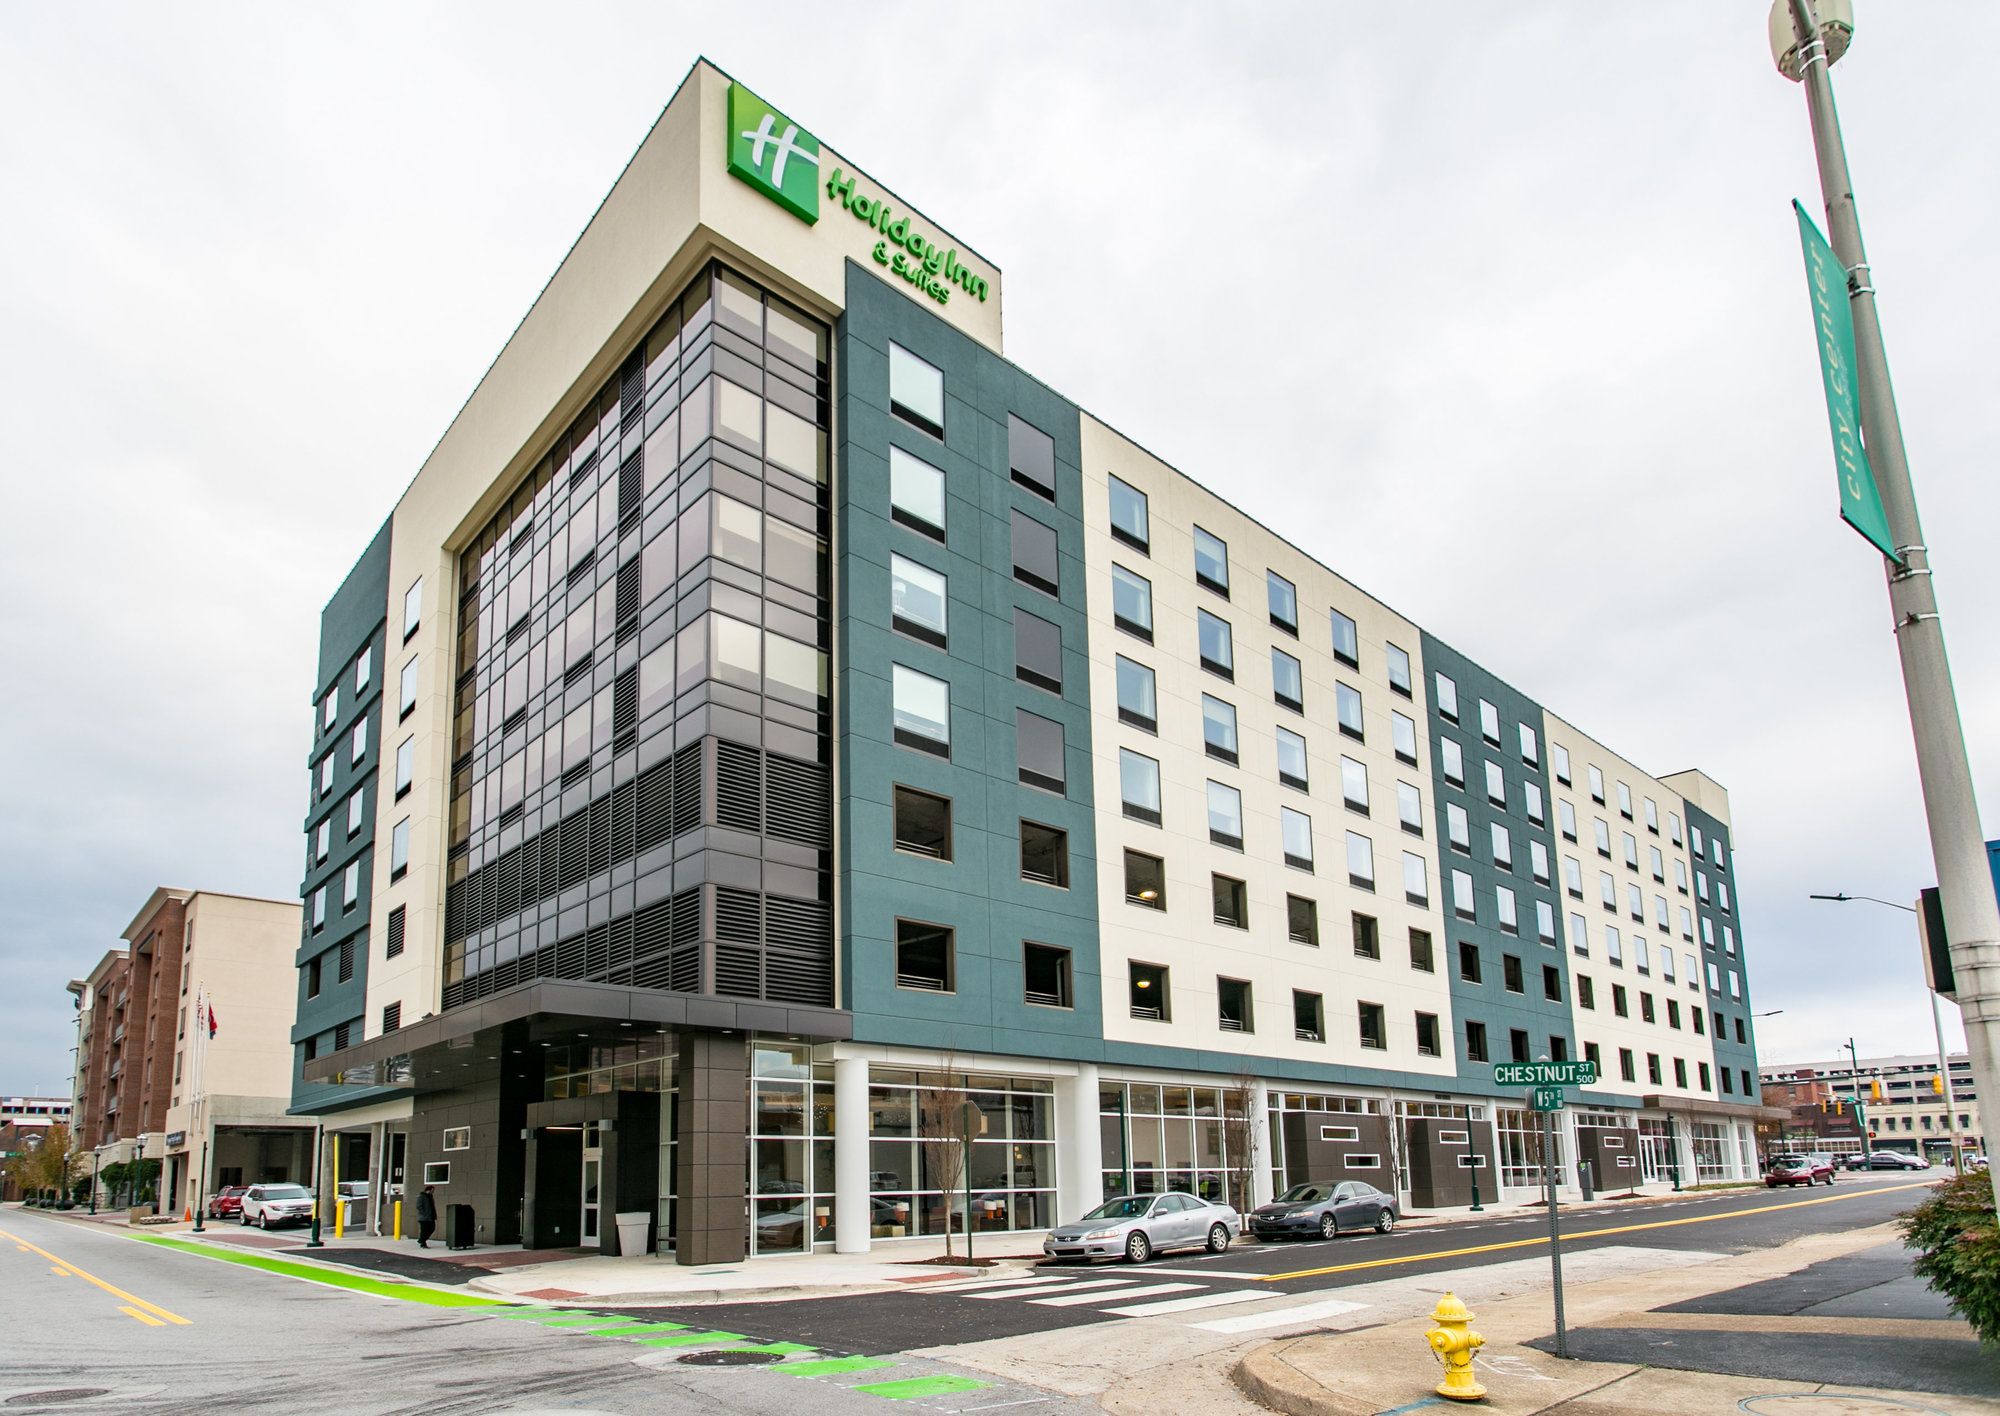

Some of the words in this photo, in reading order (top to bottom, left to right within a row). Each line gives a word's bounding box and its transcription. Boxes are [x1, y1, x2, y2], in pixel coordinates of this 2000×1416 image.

[826, 167, 944, 275] Holiday
[945, 248, 989, 303] Inn
[872, 240, 889, 267] &
[891, 251, 950, 305] Suites
[1810, 241, 1842, 395] center
[1836, 407, 1861, 501] city
[1494, 1065, 1576, 1083] CHESTNUT
[1578, 1063, 1590, 1073] ST
[1537, 1091, 1544, 1107] W
[1576, 1074, 1594, 1084] 500
